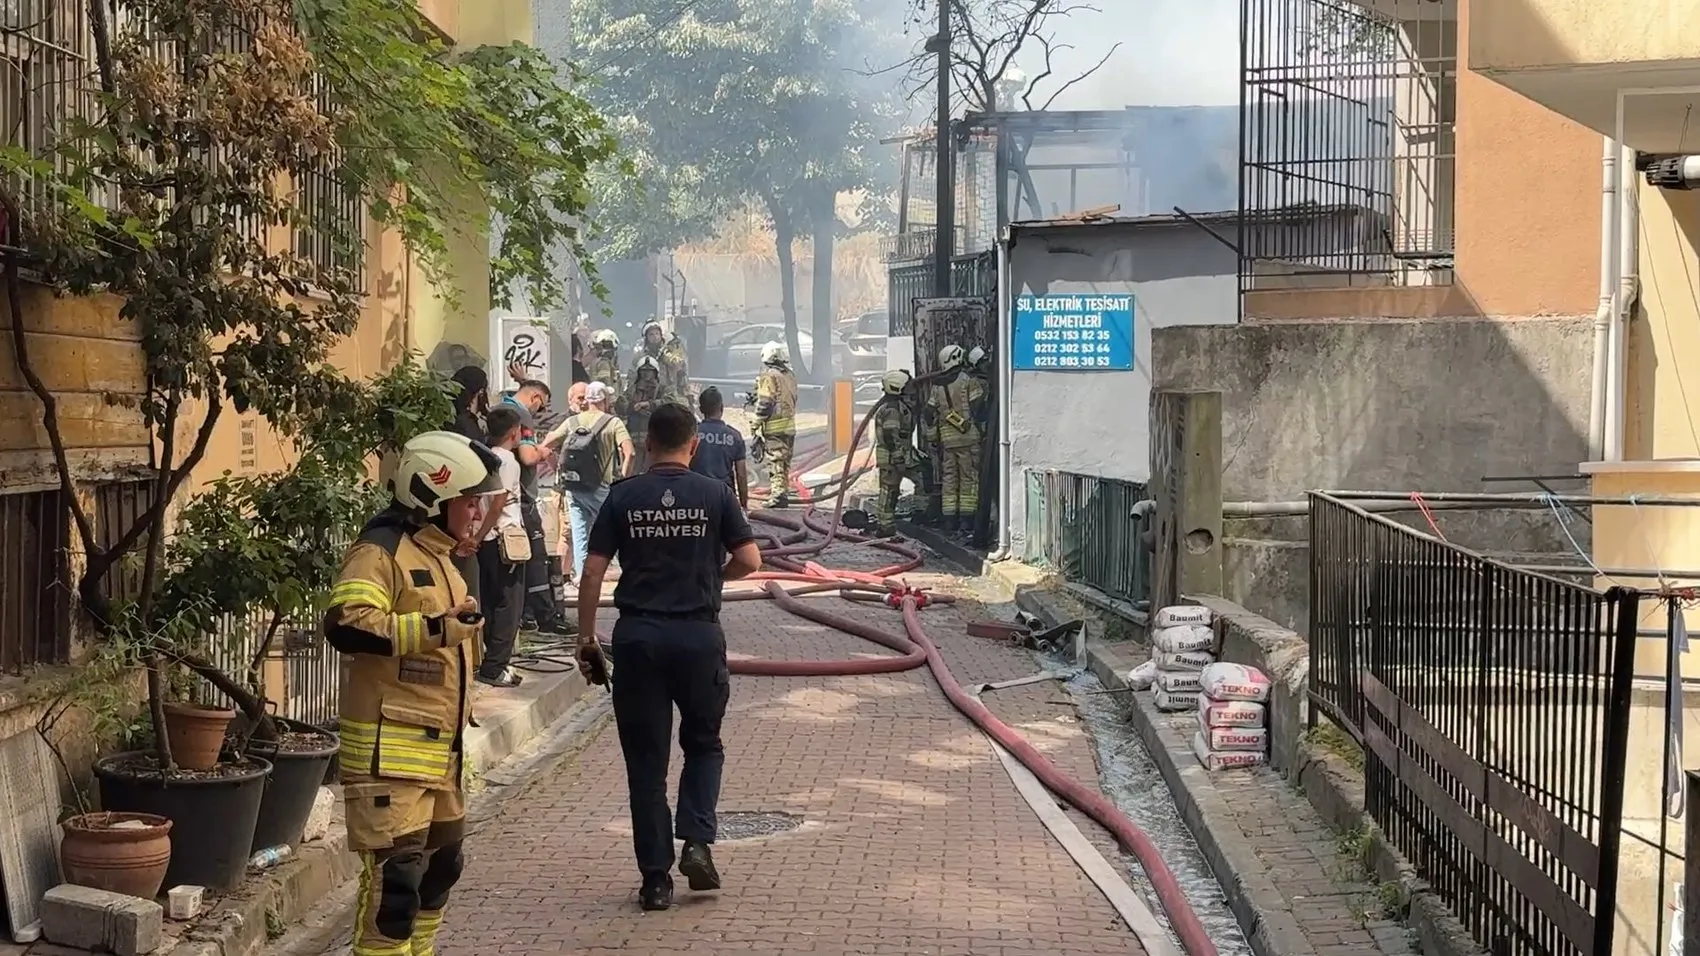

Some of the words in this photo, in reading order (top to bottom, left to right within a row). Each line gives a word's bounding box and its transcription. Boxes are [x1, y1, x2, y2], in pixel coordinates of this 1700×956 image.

[1017, 298, 1032, 313] SU,
[1035, 295, 1083, 311] ELEKTRİK
[1085, 295, 1129, 311] TESİSATI
[1043, 312, 1102, 328] HİZMETLERİ
[1034, 330, 1060, 340] 0532
[1062, 330, 1079, 340] 153
[1097, 330, 1110, 340] 35
[1034, 343, 1057, 353] 0212
[1060, 343, 1079, 353] 302
[1034, 357, 1057, 366] 0212
[1081, 357, 1094, 366] 30
[1097, 357, 1110, 366] 53
[627, 508, 709, 523] İSTANBUL
[629, 523, 707, 538] İTFAİYESİ
[1169, 614, 1203, 622] Baumit
[1178, 638, 1211, 649] Baumit
[1221, 684, 1261, 695] TEKNO
[1216, 711, 1257, 720] TEKNO
[1220, 735, 1260, 744] TEKNO
[1216, 755, 1257, 765] TEKNO
